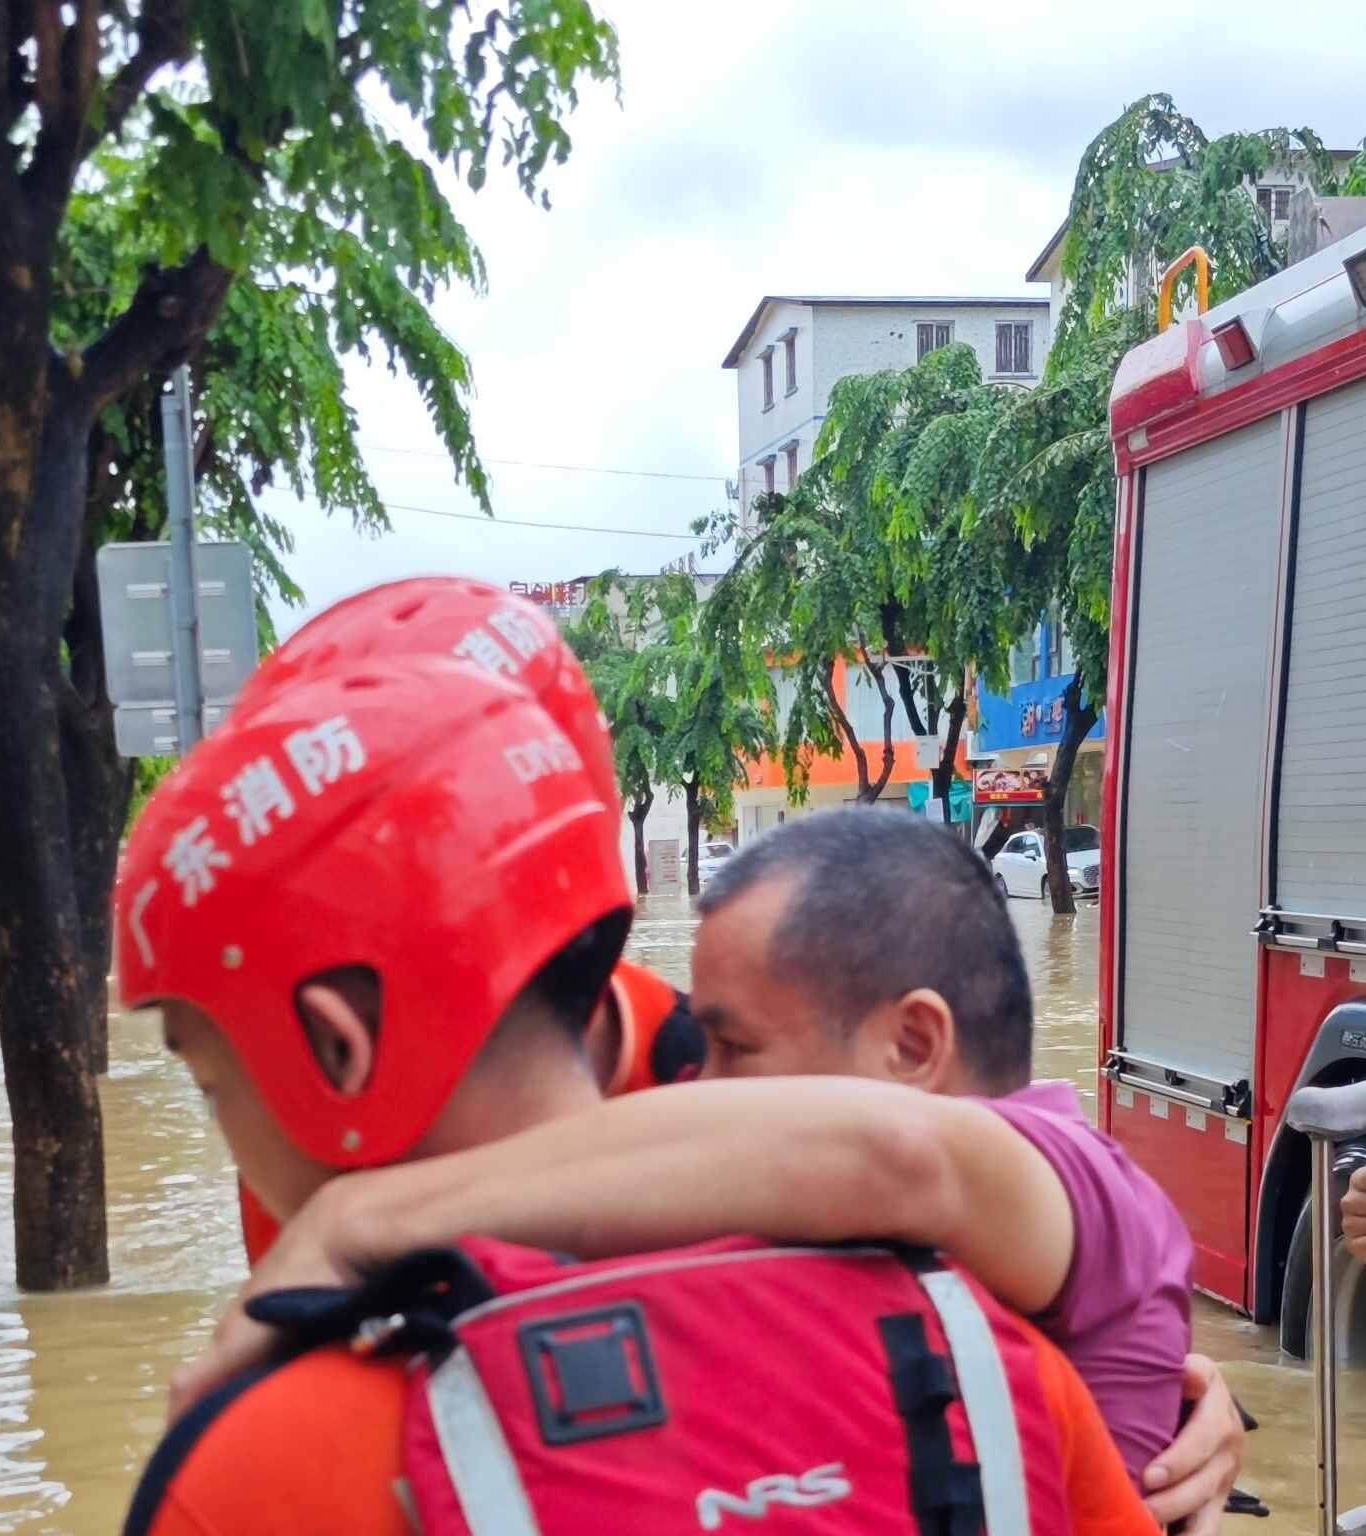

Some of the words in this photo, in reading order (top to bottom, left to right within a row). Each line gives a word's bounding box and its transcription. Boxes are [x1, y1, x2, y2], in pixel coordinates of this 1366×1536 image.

[128, 714, 368, 969] 广东消防
[695, 1461, 853, 1532] NRS
